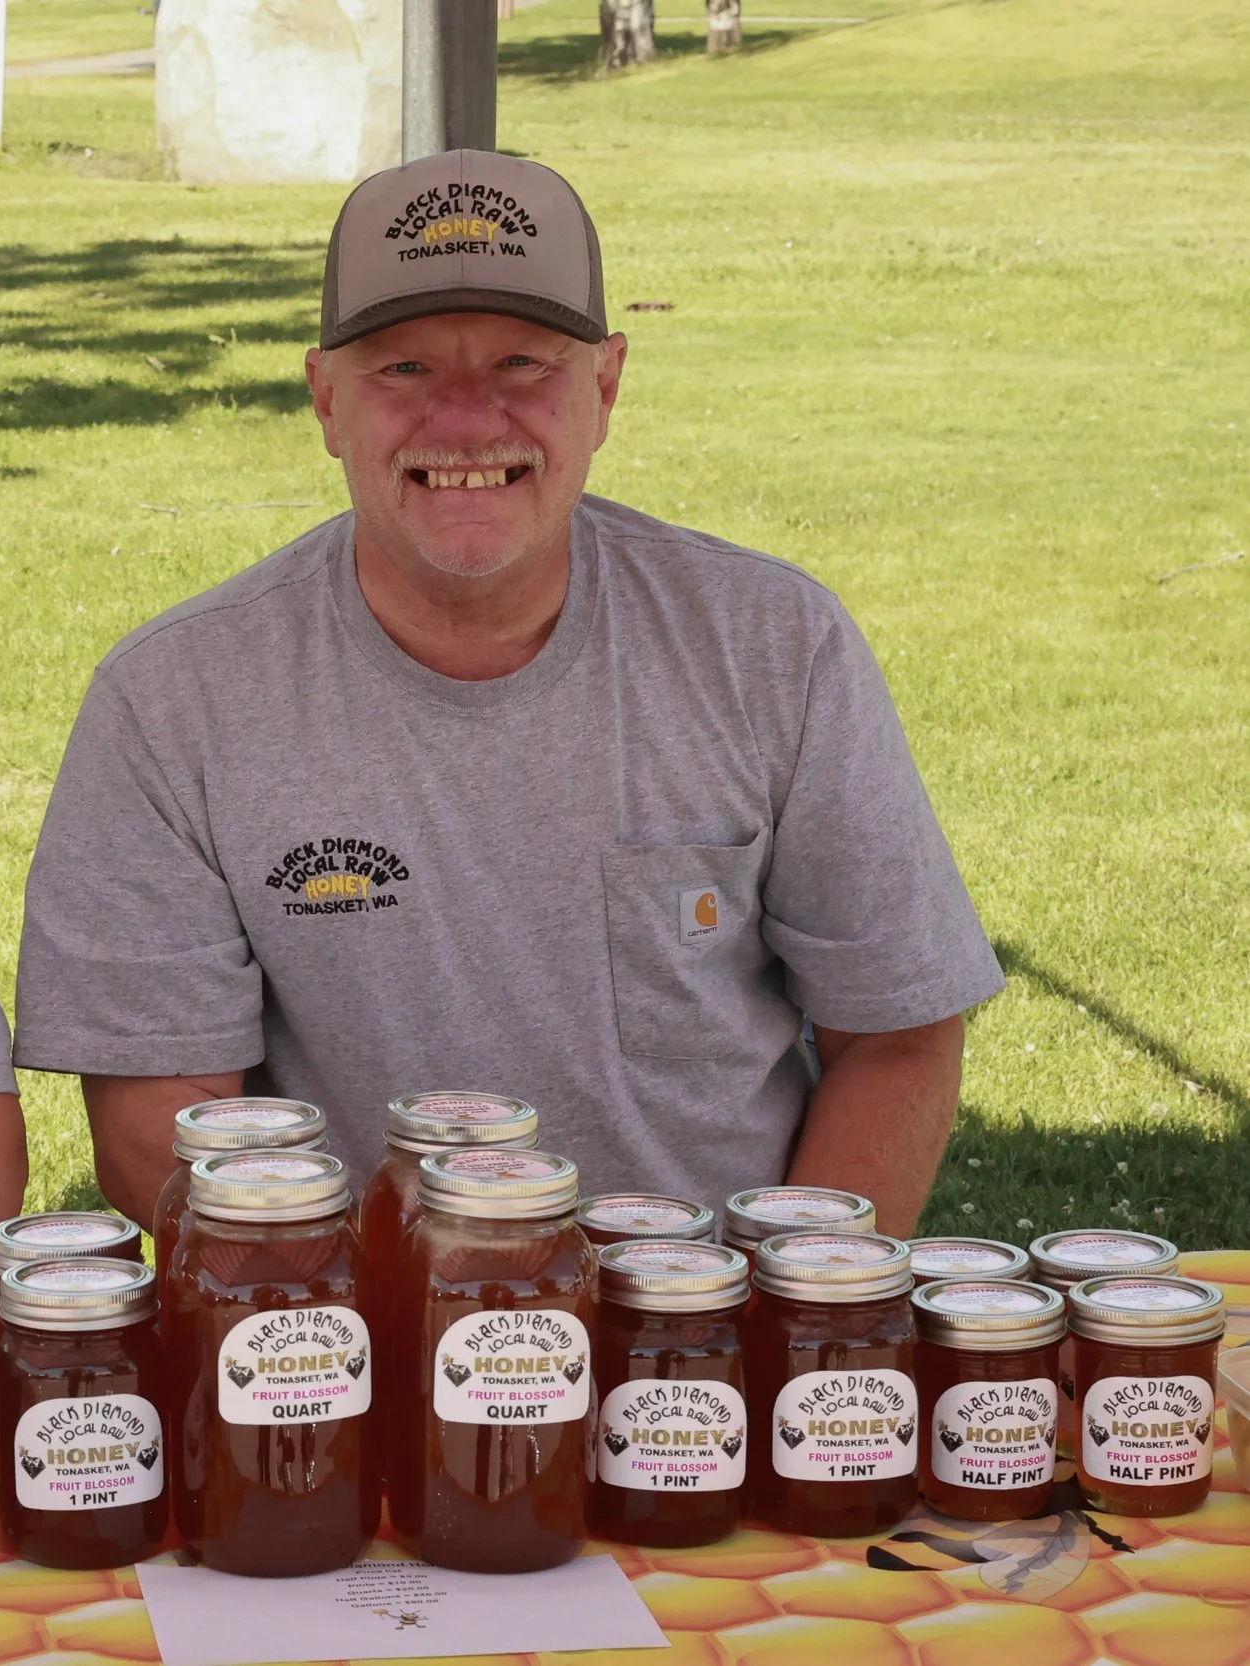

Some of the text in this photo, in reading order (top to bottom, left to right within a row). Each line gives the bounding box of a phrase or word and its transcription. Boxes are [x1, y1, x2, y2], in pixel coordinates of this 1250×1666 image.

[385, 183, 538, 240] BLACK DIAMOND
[403, 199, 520, 240] LOCAL RAW
[423, 217, 499, 243] HONEY
[398, 241, 527, 262] TONASKET, WA
[265, 837, 410, 889] BLACK DIAMOND
[284, 855, 391, 893] LOCAL RAW
[305, 874, 371, 902] HONEY
[283, 894, 398, 915] TONASKET, WA
[247, 1311, 353, 1353] BLACK DIAMOND
[465, 1313, 572, 1352] BLACK DIAMOND
[271, 1332, 336, 1352] LOCAL RAW
[488, 1333, 554, 1353] LOCAL RAW
[258, 1351, 349, 1373] HONEY
[474, 1355, 568, 1374] HONEY
[266, 1375, 321, 1385] TONASKET,
[482, 1377, 538, 1385] TONASKET,
[253, 1385, 348, 1401] FRUIT BLOSSOM
[468, 1389, 565, 1400] FRUIT BLOSSOM
[798, 1376, 904, 1415] BLACK DIAMOND
[1103, 1382, 1202, 1416] BLACK DIAMOND
[272, 1401, 332, 1418] QUART
[487, 1405, 548, 1418] QUART
[623, 1386, 731, 1423] BLACK DIAMOND
[821, 1396, 888, 1416] LOCAL RAW
[958, 1386, 1051, 1422] BLACK DIAMOND
[1123, 1401, 1187, 1419] LOCAL RAW
[37, 1402, 144, 1444] BLACK DIAMOND
[645, 1406, 713, 1426] LOCAL RAW
[979, 1406, 1039, 1424] LOCAL RAW
[59, 1423, 126, 1444] LOCAL RAW
[808, 1417, 900, 1436] HONEY
[966, 1422, 1048, 1443] HONEY
[1112, 1418, 1198, 1438] HONEY
[631, 1428, 726, 1446] HONEY
[816, 1439, 871, 1447] TONASKET,
[1119, 1440, 1172, 1448] TONASKET,
[47, 1442, 141, 1465] HONEY
[639, 1448, 695, 1458] TONASKET,
[809, 1451, 893, 1462] FRUIT BLOSSOM
[973, 1446, 1025, 1454] TONASKET,
[1107, 1450, 1198, 1464] FRUIT BLOSSOM
[56, 1463, 130, 1476] TONASKET, WA
[632, 1461, 717, 1472] FRUIT BLOSSOM
[828, 1465, 876, 1476] 1 PINT
[960, 1454, 1046, 1468] FRUIT BLOSSOM
[651, 1476, 699, 1487] 1 PINT
[962, 1467, 1044, 1485] HALF PINT
[1110, 1464, 1195, 1480] HALF PINT
[50, 1476, 135, 1491] FRUIT BLOSSOM
[70, 1491, 117, 1505] 1 PINT
